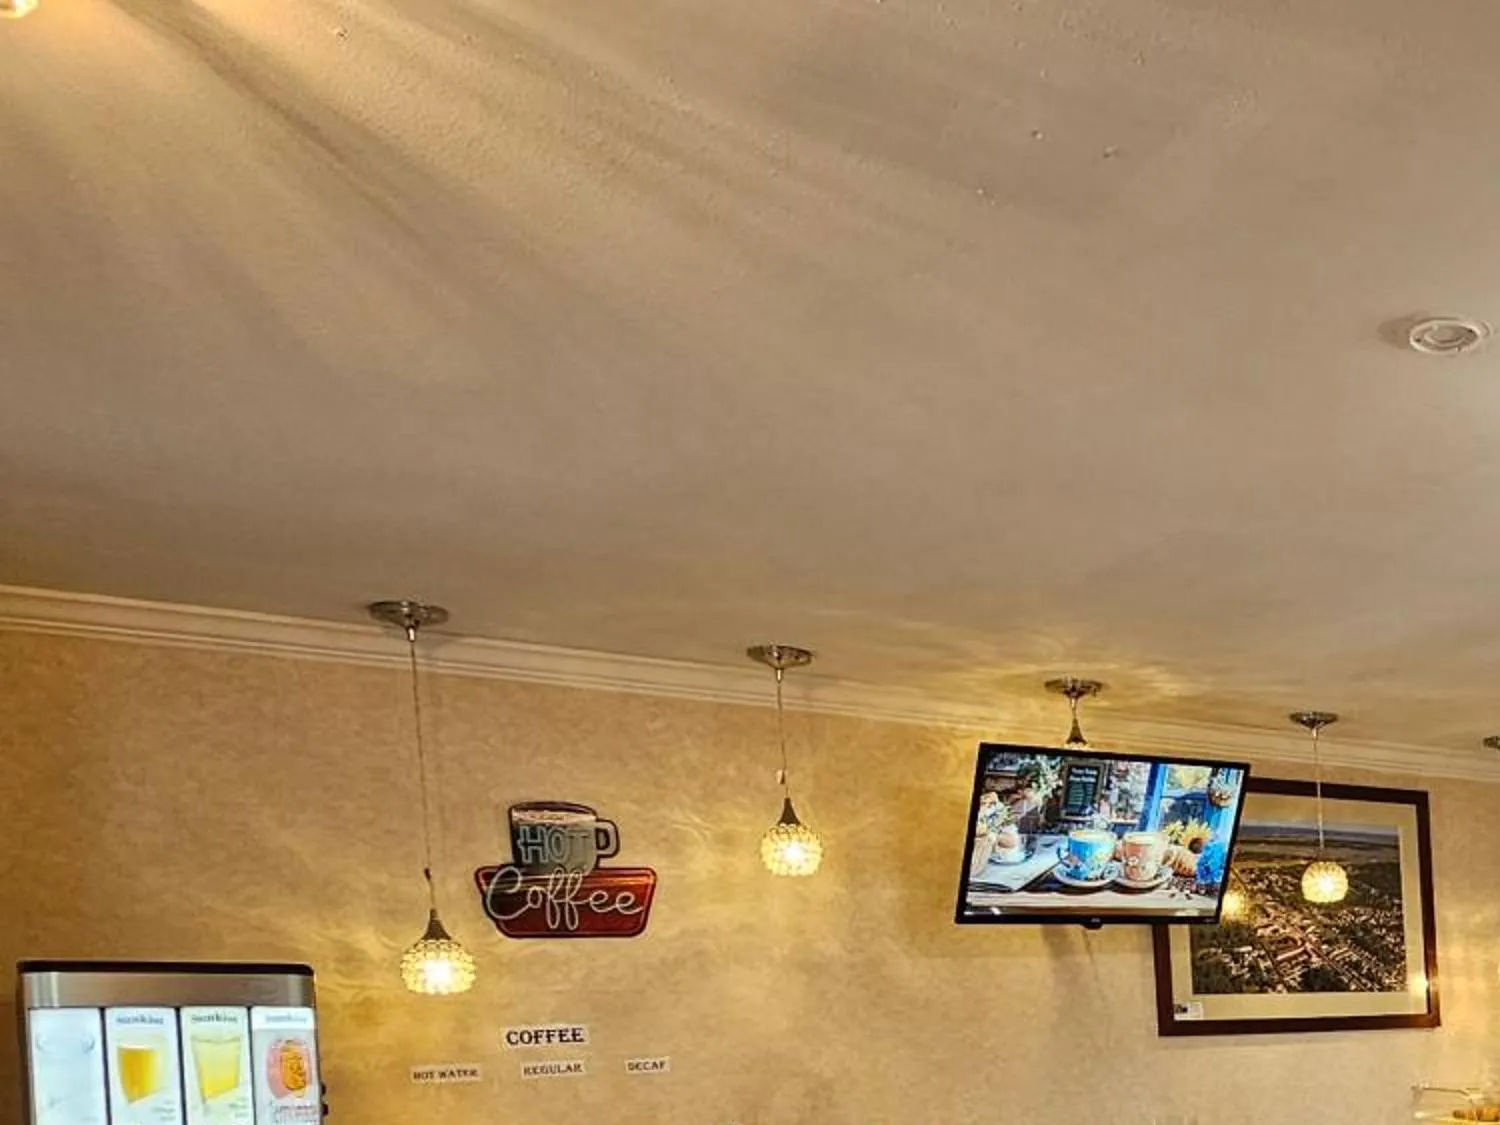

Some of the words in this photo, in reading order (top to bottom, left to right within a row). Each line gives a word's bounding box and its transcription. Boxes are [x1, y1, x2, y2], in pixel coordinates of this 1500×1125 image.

[485, 865, 645, 931] Coffee
[505, 1027, 585, 1045] COFFEE
[523, 1062, 583, 1076] REGULAR
[627, 1060, 666, 1072] DECAF
